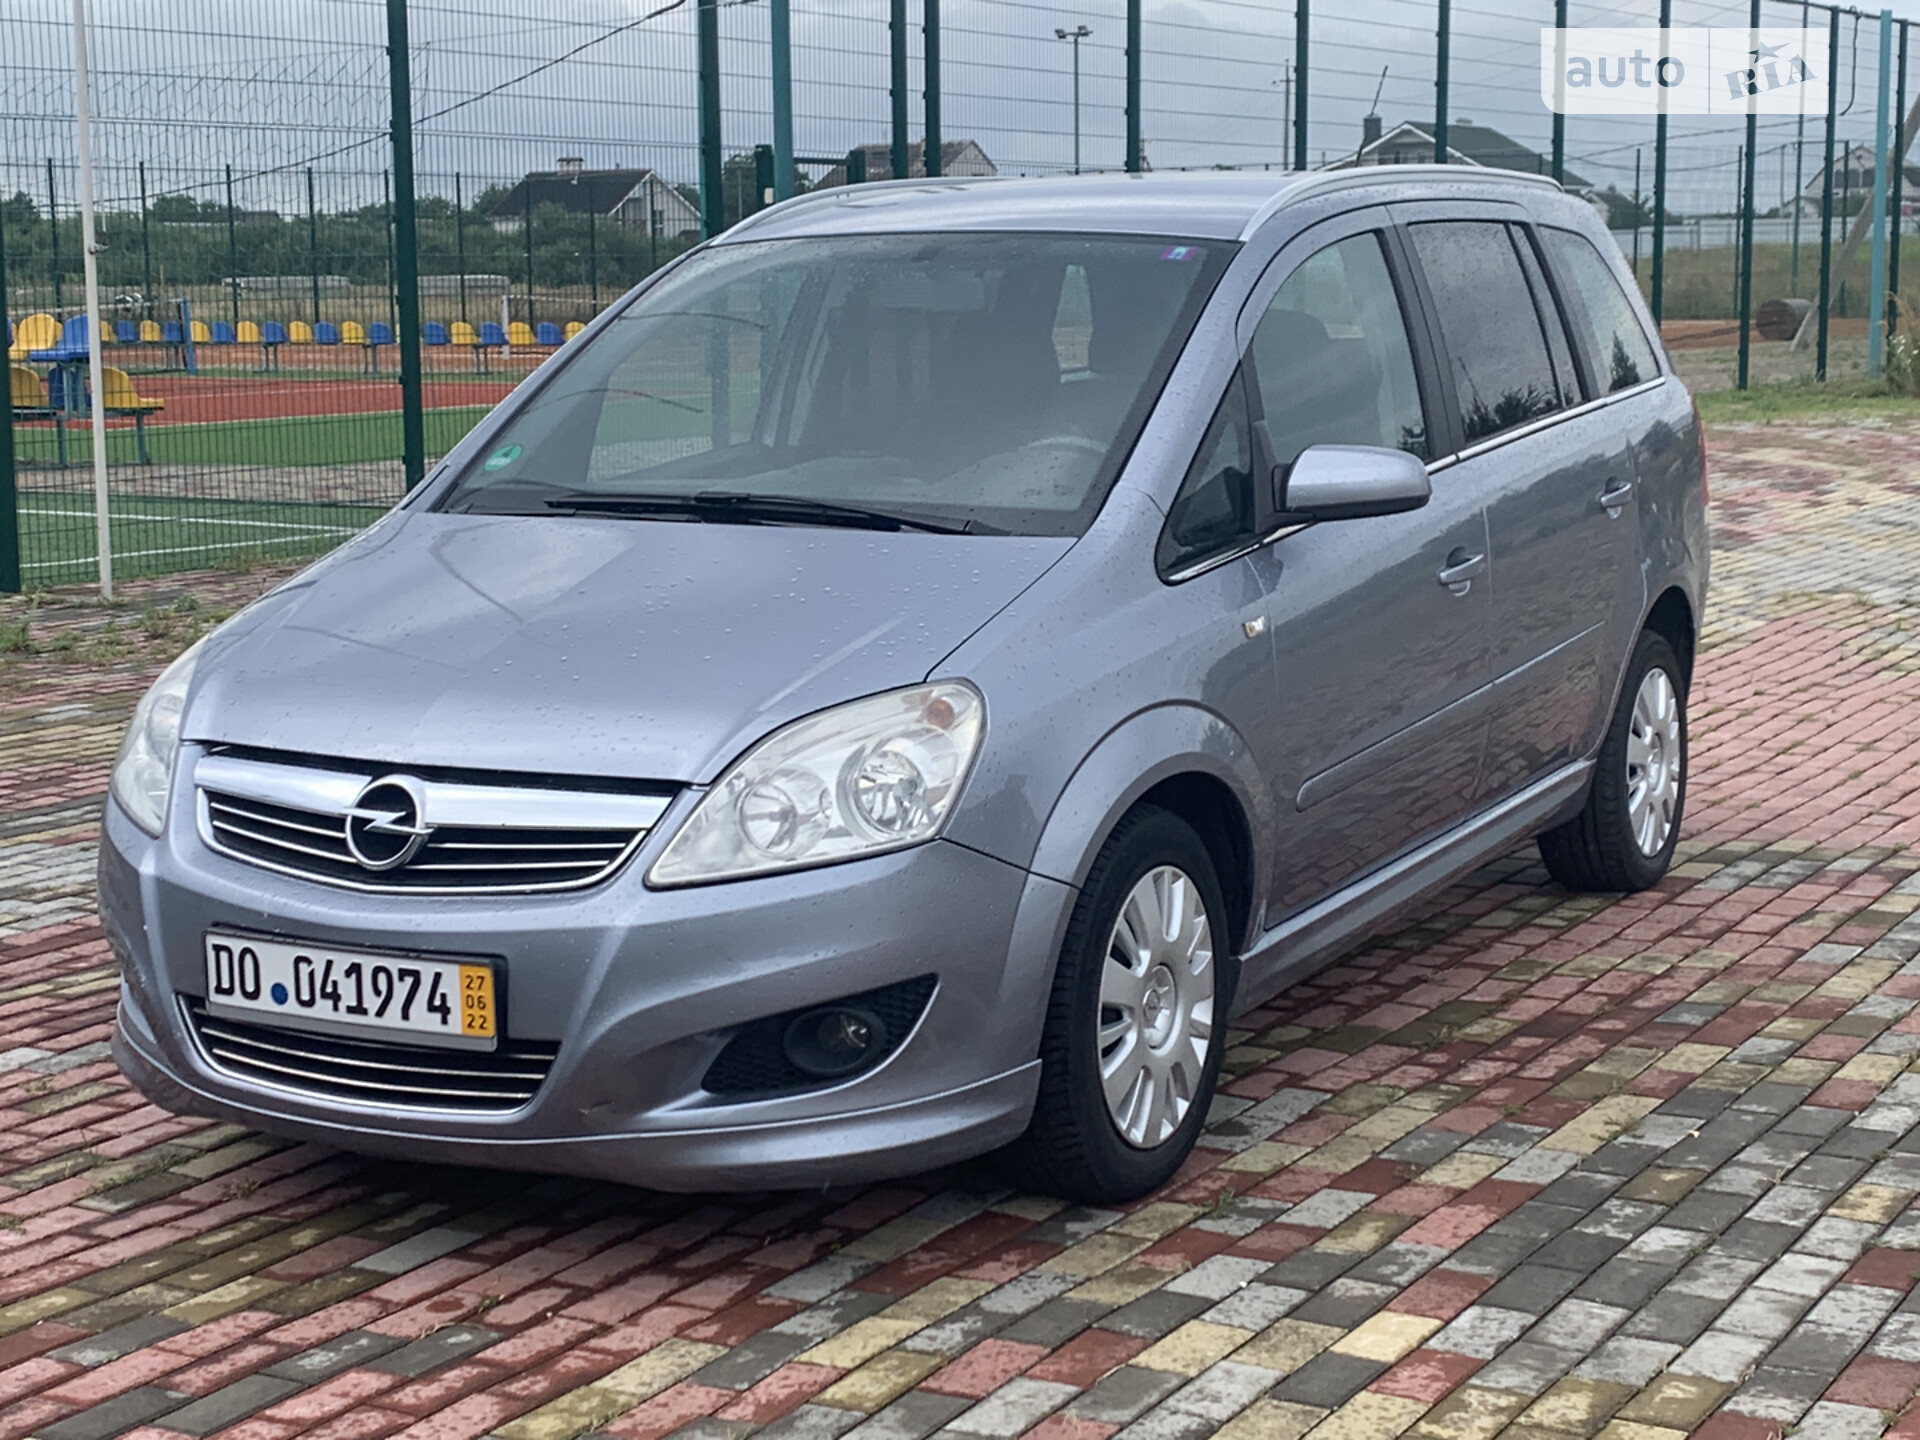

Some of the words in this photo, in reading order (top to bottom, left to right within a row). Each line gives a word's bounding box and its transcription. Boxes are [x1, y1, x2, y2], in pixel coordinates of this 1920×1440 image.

[212, 943, 261, 1000] DO
[293, 955, 451, 1025] 041974
[465, 974, 485, 990] 27
[465, 994, 486, 1010] 06
[466, 1013, 487, 1030] 22
